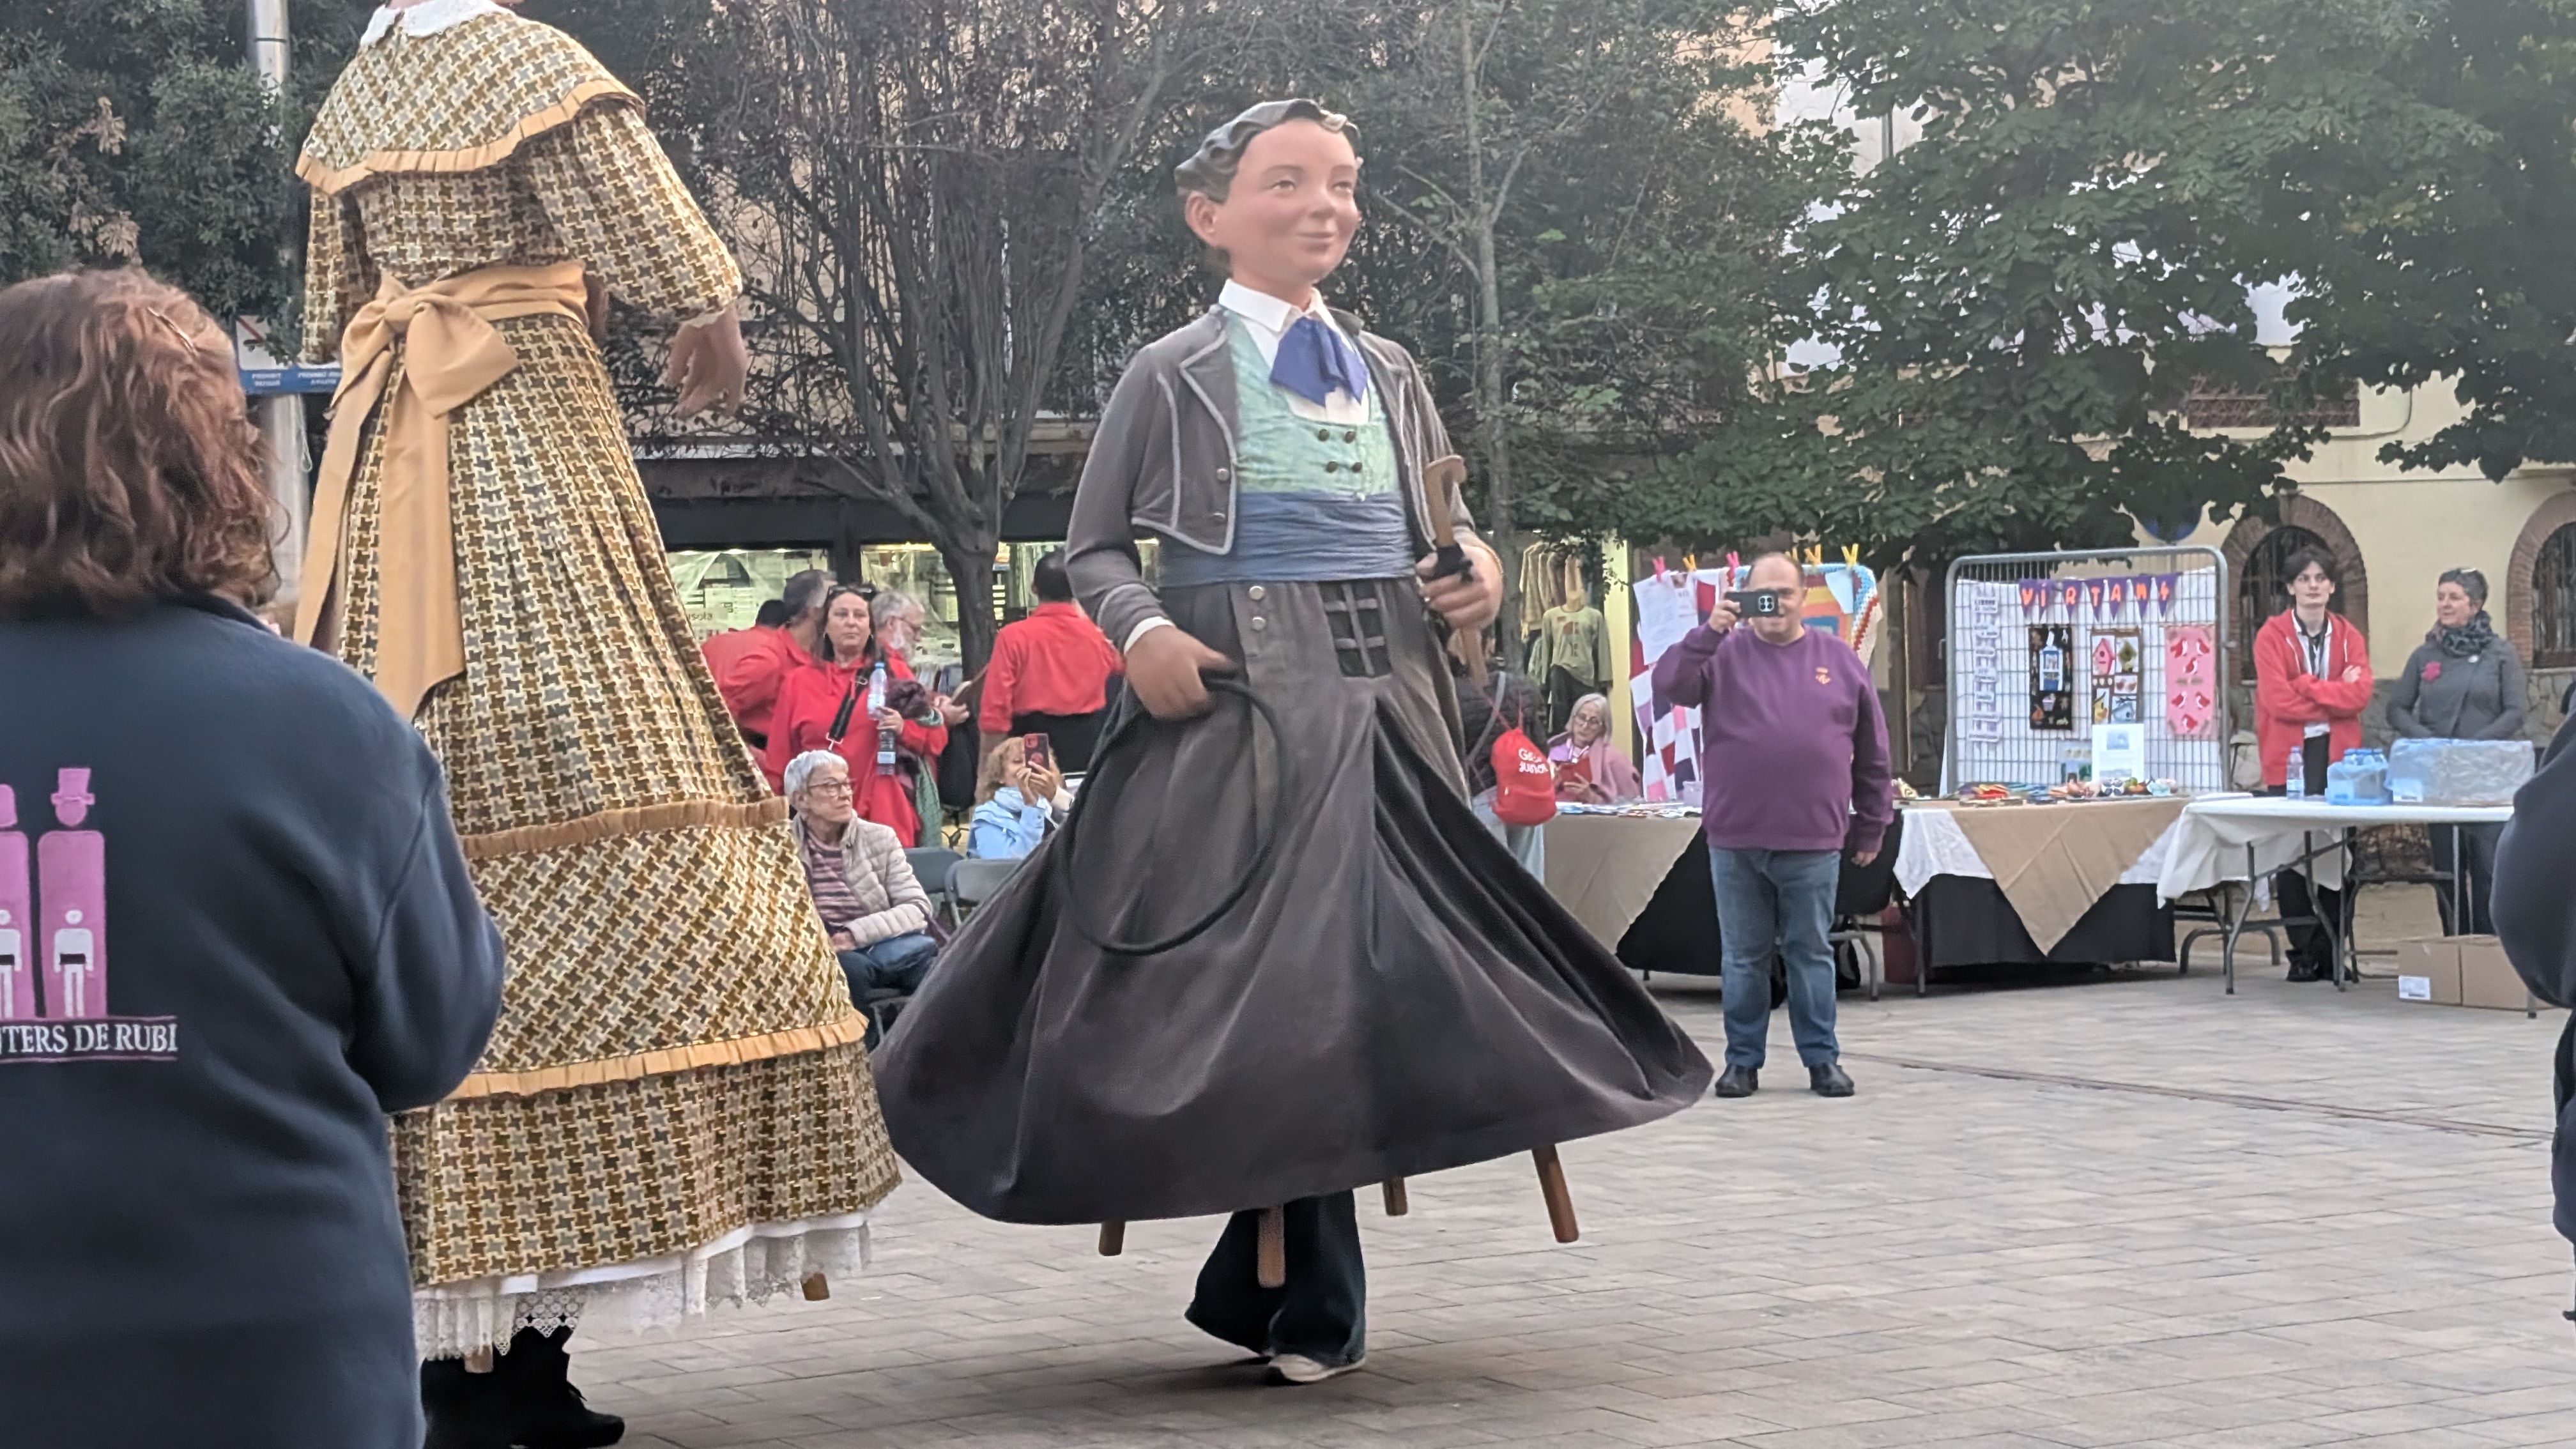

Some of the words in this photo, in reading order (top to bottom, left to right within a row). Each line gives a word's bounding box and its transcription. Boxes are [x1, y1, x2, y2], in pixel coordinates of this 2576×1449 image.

[0, 1024, 68, 1054] TERS
[73, 1023, 109, 1052] DE
[114, 1022, 178, 1052] RUBI
